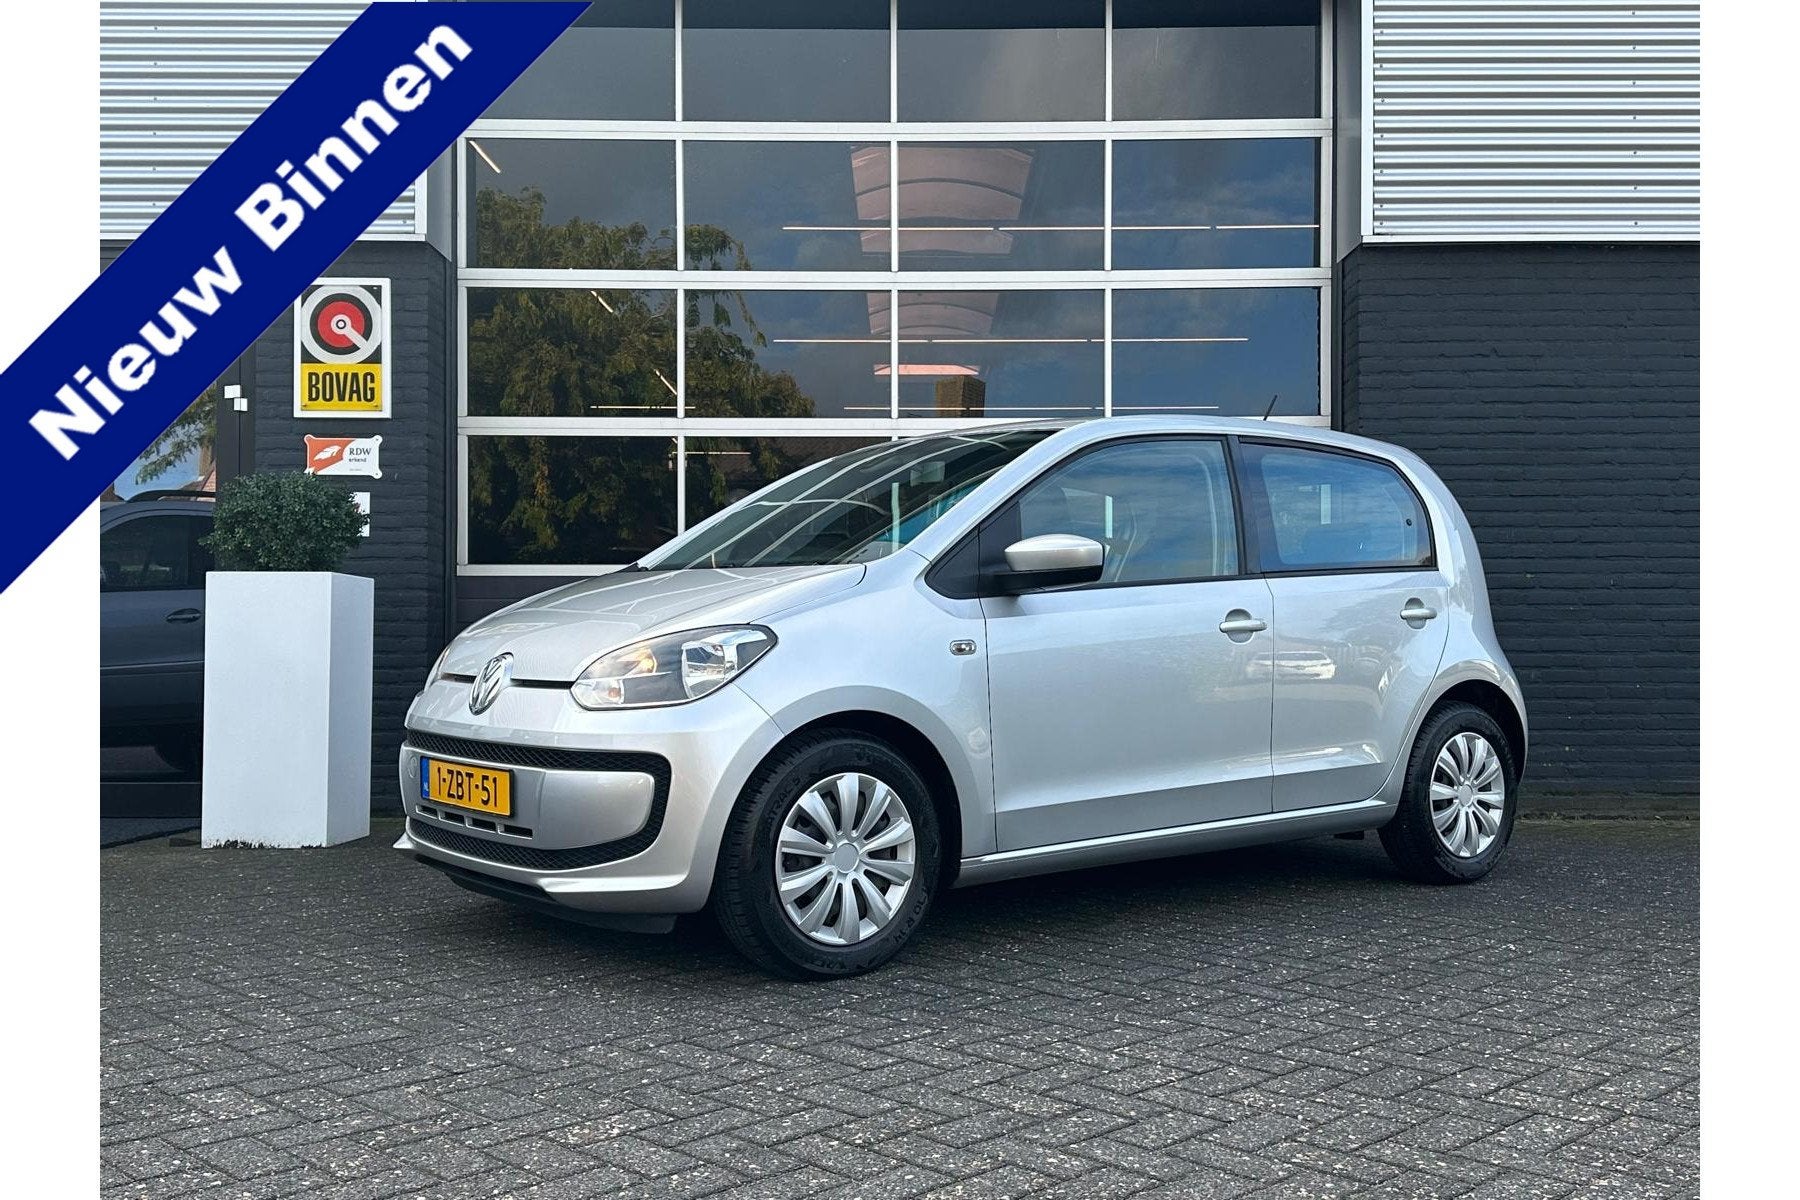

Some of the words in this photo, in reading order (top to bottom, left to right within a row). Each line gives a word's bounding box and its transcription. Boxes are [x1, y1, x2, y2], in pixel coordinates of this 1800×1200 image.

[307, 371, 376, 402] BOVAG
[349, 447, 372, 456] RDW
[437, 766, 498, 808] 1-ZBT-51
